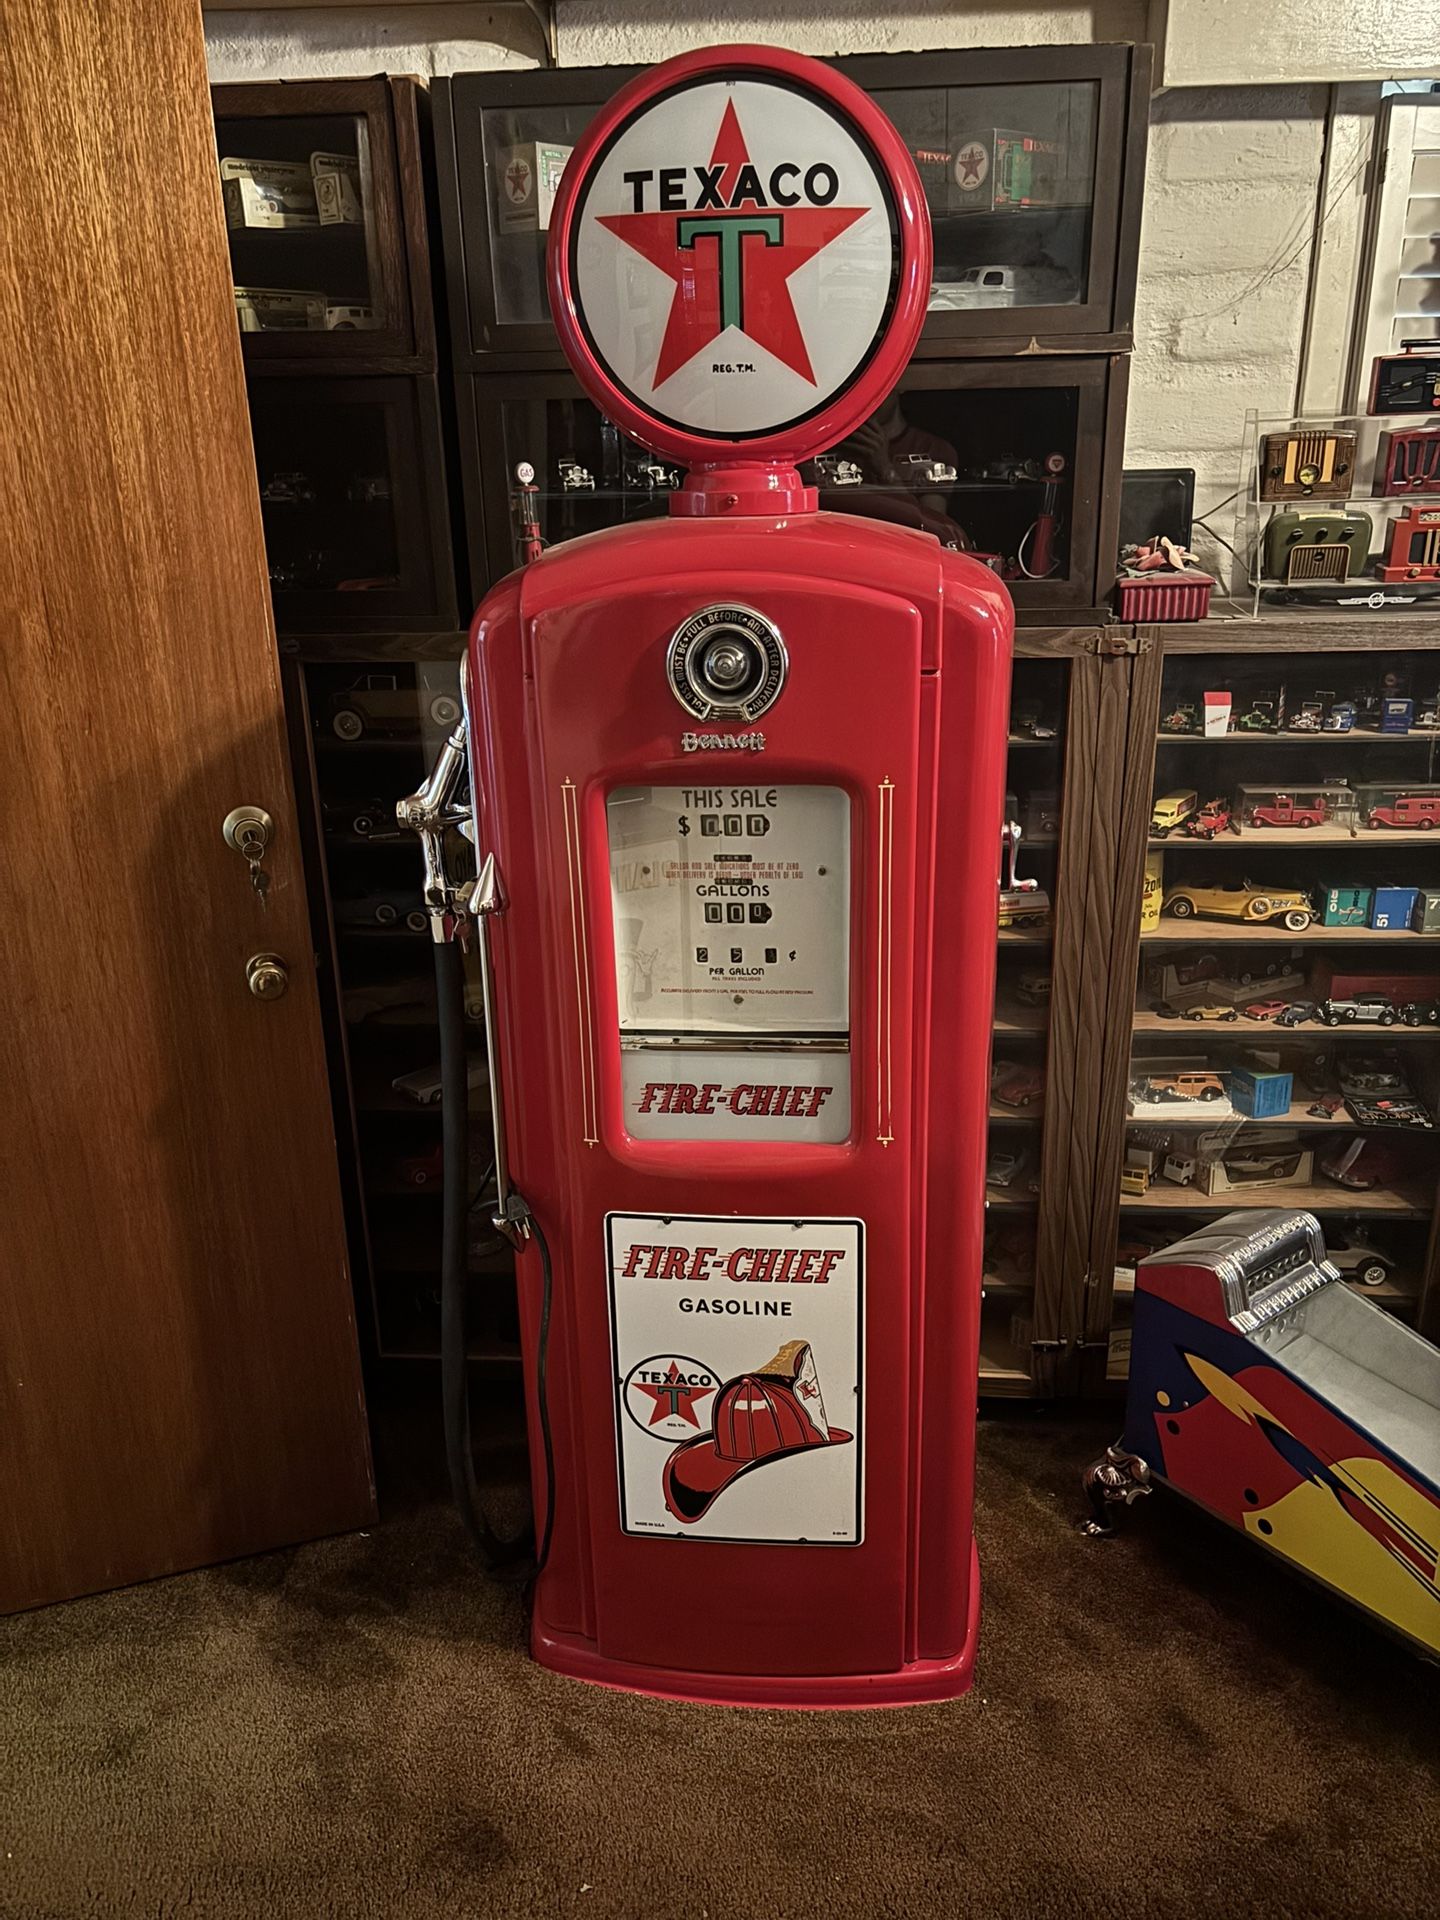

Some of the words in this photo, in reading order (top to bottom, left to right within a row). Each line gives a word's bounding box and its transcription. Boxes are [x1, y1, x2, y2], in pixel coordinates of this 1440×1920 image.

[624, 162, 839, 213] TEXACO
[677, 213, 784, 332] T
[712, 364, 736, 373] REG.
[736, 363, 756, 373] T.M.
[519, 467, 533, 478] GAS
[708, 611, 744, 624] BEFORE
[746, 618, 766, 635] AND
[686, 618, 707, 639] FULL
[677, 641, 688, 655] BE
[762, 633, 780, 667] AFTER
[673, 655, 685, 681] MUST
[677, 681, 702, 710] GLASS
[754, 669, 780, 711] DELIVERY
[681, 732, 766, 752] Bennett
[681, 789, 723, 808] THIS
[731, 789, 777, 808] SALE
[678, 815, 691, 837] $
[696, 885, 770, 897] GALLONS
[1376, 913, 1390, 928] 51
[709, 967, 725, 976] PER
[728, 967, 765, 976] GALLON
[636, 1083, 833, 1117] FIRE-CHIEF
[622, 1244, 846, 1283] FIRE-CHIEF
[679, 1298, 792, 1316] GASOLINE
[639, 1371, 712, 1387] TEXACO
[656, 1386, 690, 1415] T
